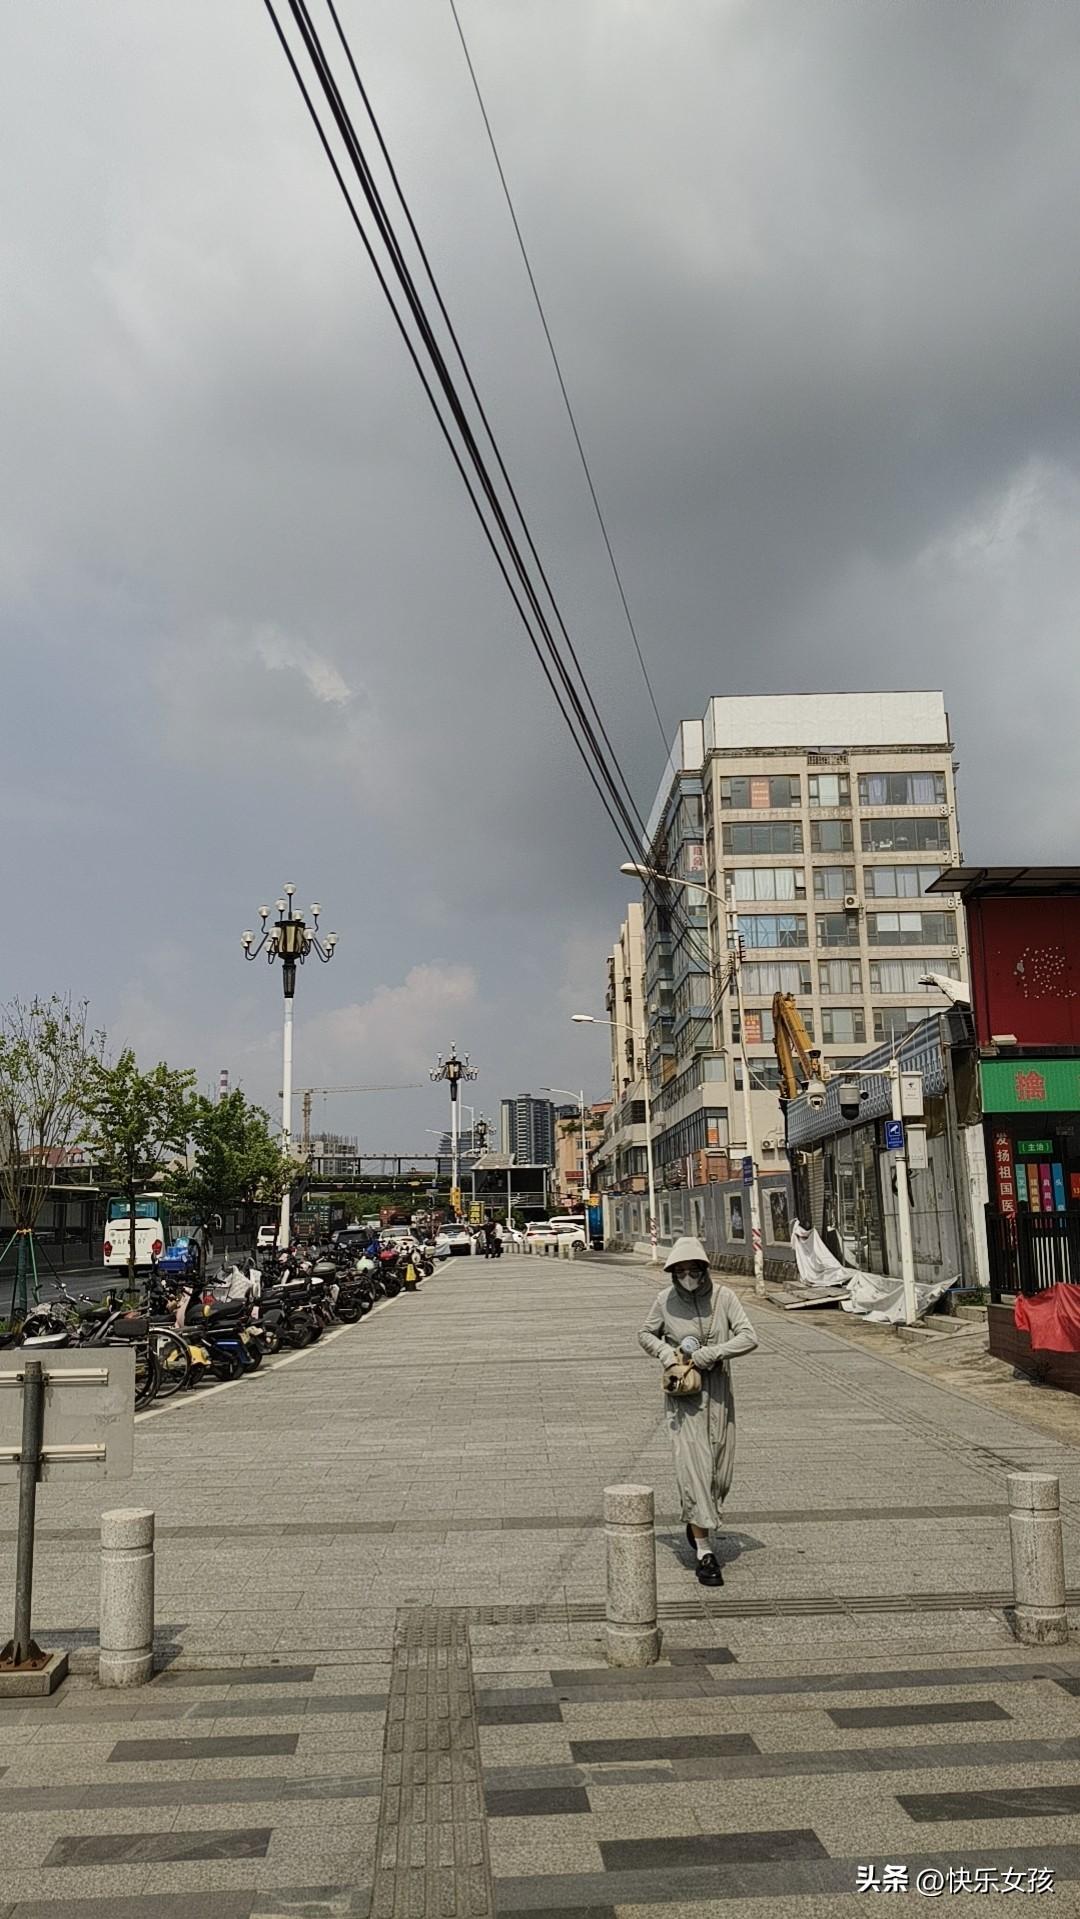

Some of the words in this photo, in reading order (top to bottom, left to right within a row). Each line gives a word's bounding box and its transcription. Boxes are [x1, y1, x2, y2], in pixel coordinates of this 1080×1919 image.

[940, 806, 955, 817] 8F
[943, 851, 958, 863] 7F
[947, 897, 962, 909] 6F
[951, 945, 966, 957] 5F
[996, 1132, 1017, 1228] 发扬祖国医
